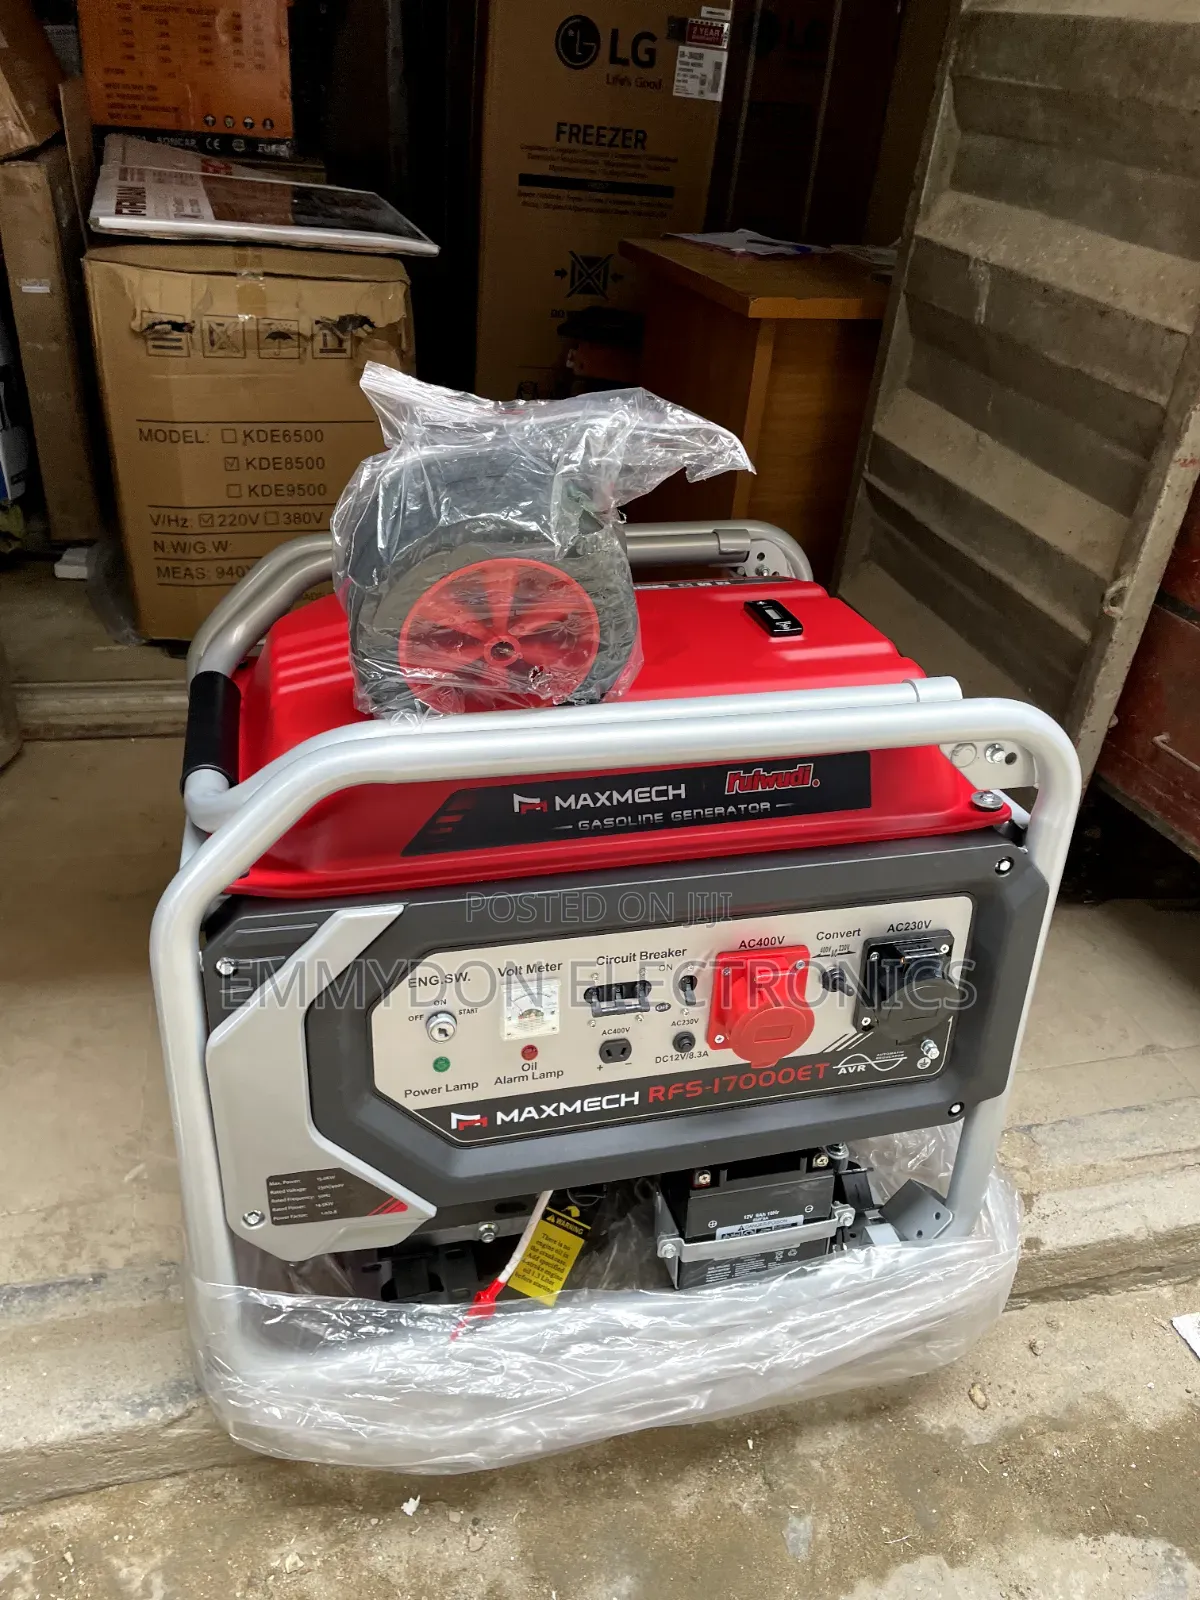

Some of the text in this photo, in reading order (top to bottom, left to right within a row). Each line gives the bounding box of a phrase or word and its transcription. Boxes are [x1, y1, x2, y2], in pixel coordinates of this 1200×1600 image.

[610, 28, 657, 68] LG
[556, 122, 648, 150] FREEZER
[138, 428, 324, 444] MODEL: KDE6500
[245, 456, 326, 471] KDE8500
[248, 484, 327, 498] KDE9500
[218, 513, 260, 527] 220V
[282, 511, 324, 525] 380V
[555, 783, 686, 811] MAXMECH
[578, 802, 771, 831] GASOLINE GENERATOR
[816, 927, 861, 941] Convert
[887, 920, 932, 933] AC230V
[738, 936, 785, 950] AC400V
[596, 948, 687, 966] Circuit Breaker
[498, 962, 563, 978] Volt Meter
[659, 964, 673, 972] ON
[408, 972, 471, 988] ENG.SW.
[458, 1007, 478, 1015] START
[671, 1018, 700, 1027] AC230V
[602, 1027, 630, 1036] AC400V
[655, 1050, 709, 1064] DC12V/8.3A
[521, 1061, 537, 1072] Oil
[838, 1065, 866, 1075] AVR
[494, 1069, 564, 1086] Alarm Lamp
[404, 1081, 479, 1098] Power Lamp
[497, 1062, 830, 1125] MAXMECH RFS-17000ET
[555, 1217, 584, 1235] WARNING
[535, 1240, 554, 1252] engine
[555, 1247, 563, 1255] oil
[541, 1232, 557, 1245] There
[558, 1240, 563, 1248] is
[527, 1253, 565, 1273] Add specified
[514, 1272, 533, 1284] before
[544, 1270, 563, 1282] engine
